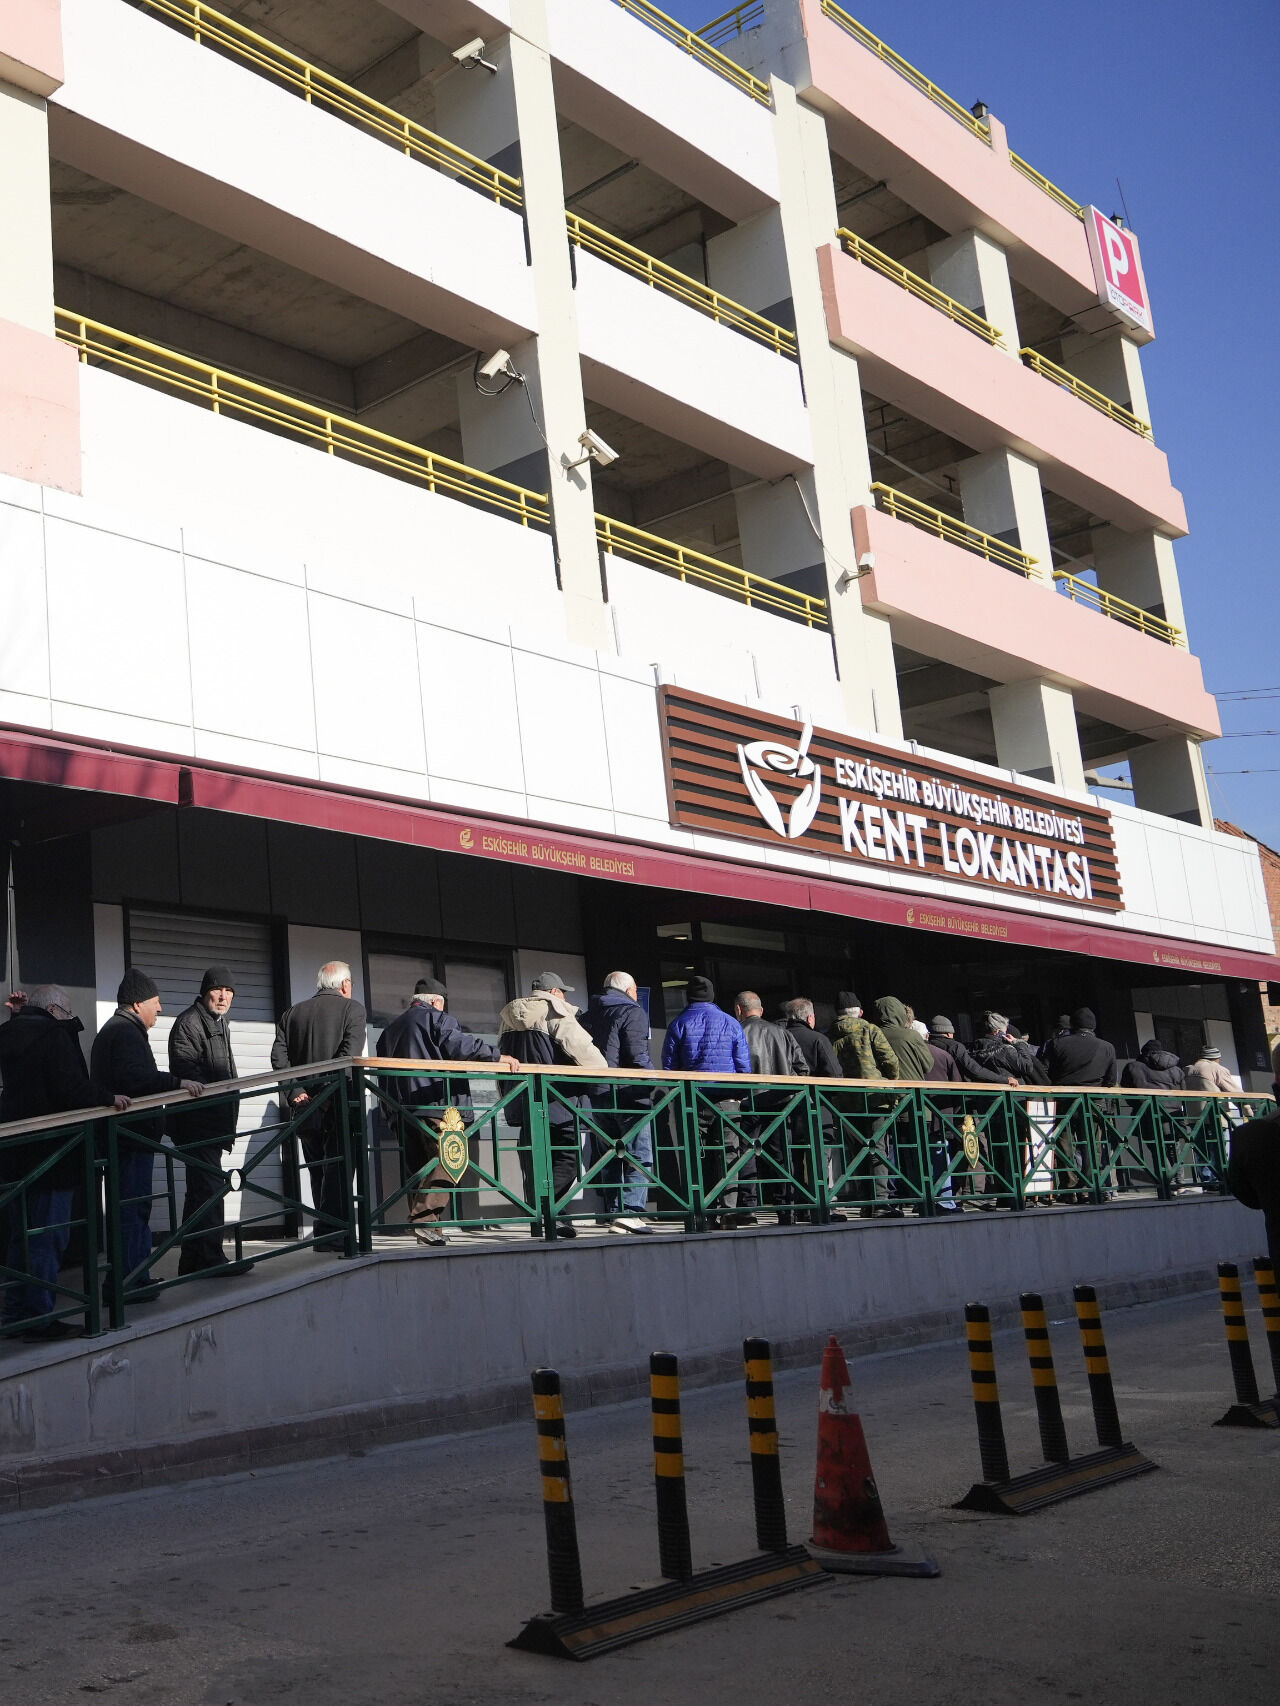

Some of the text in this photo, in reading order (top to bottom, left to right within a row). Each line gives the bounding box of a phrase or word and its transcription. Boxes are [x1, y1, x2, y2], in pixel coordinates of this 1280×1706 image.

[1102, 220, 1129, 288] P
[834, 756, 1085, 844] ESKİŞEHİR BÜYÜKŞEHİR BELEDİYESİ
[482, 835, 635, 877] ESKİŞEHİR BÜYÜKŞEHİR BELEDİYESİ
[838, 796, 1093, 900] KENT LOKANTASI
